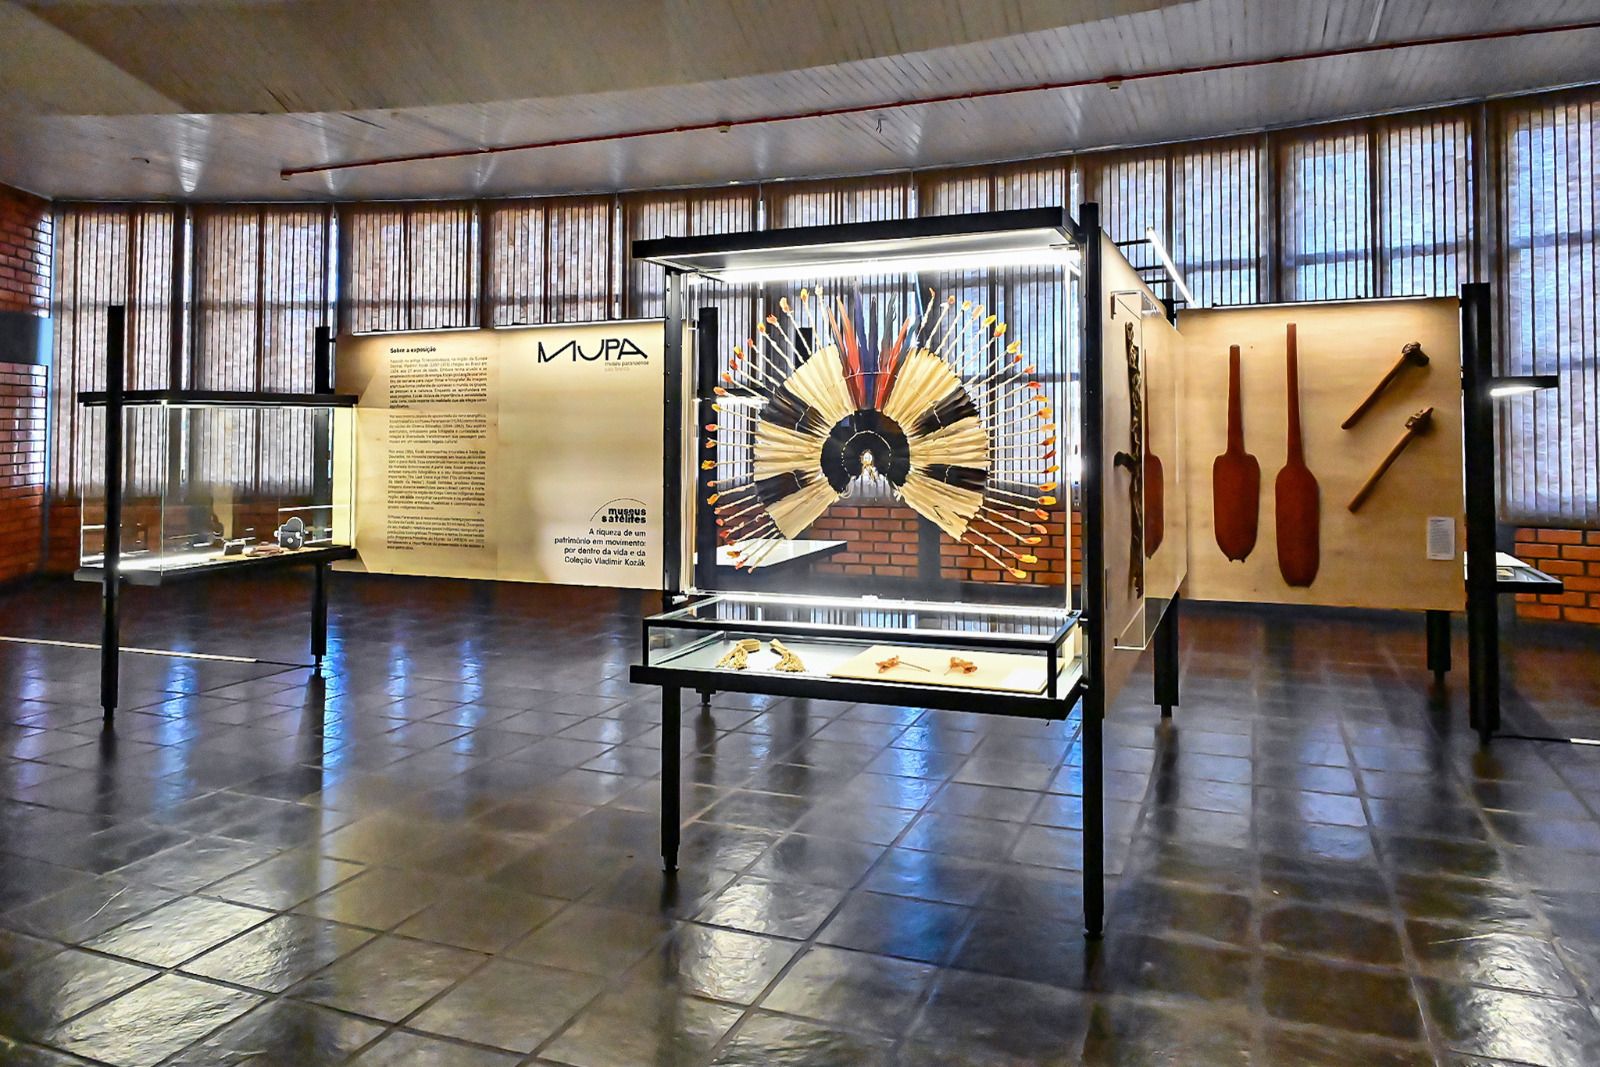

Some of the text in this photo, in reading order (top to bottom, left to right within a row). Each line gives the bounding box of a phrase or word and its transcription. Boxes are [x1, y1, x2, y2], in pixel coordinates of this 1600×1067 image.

[410, 346, 436, 354] exposição
[538, 338, 648, 363] MUPA
[596, 528, 621, 537] riqueza
[554, 537, 590, 545] patrimônio
[564, 556, 646, 567] Coleção Vladimir Kozák
